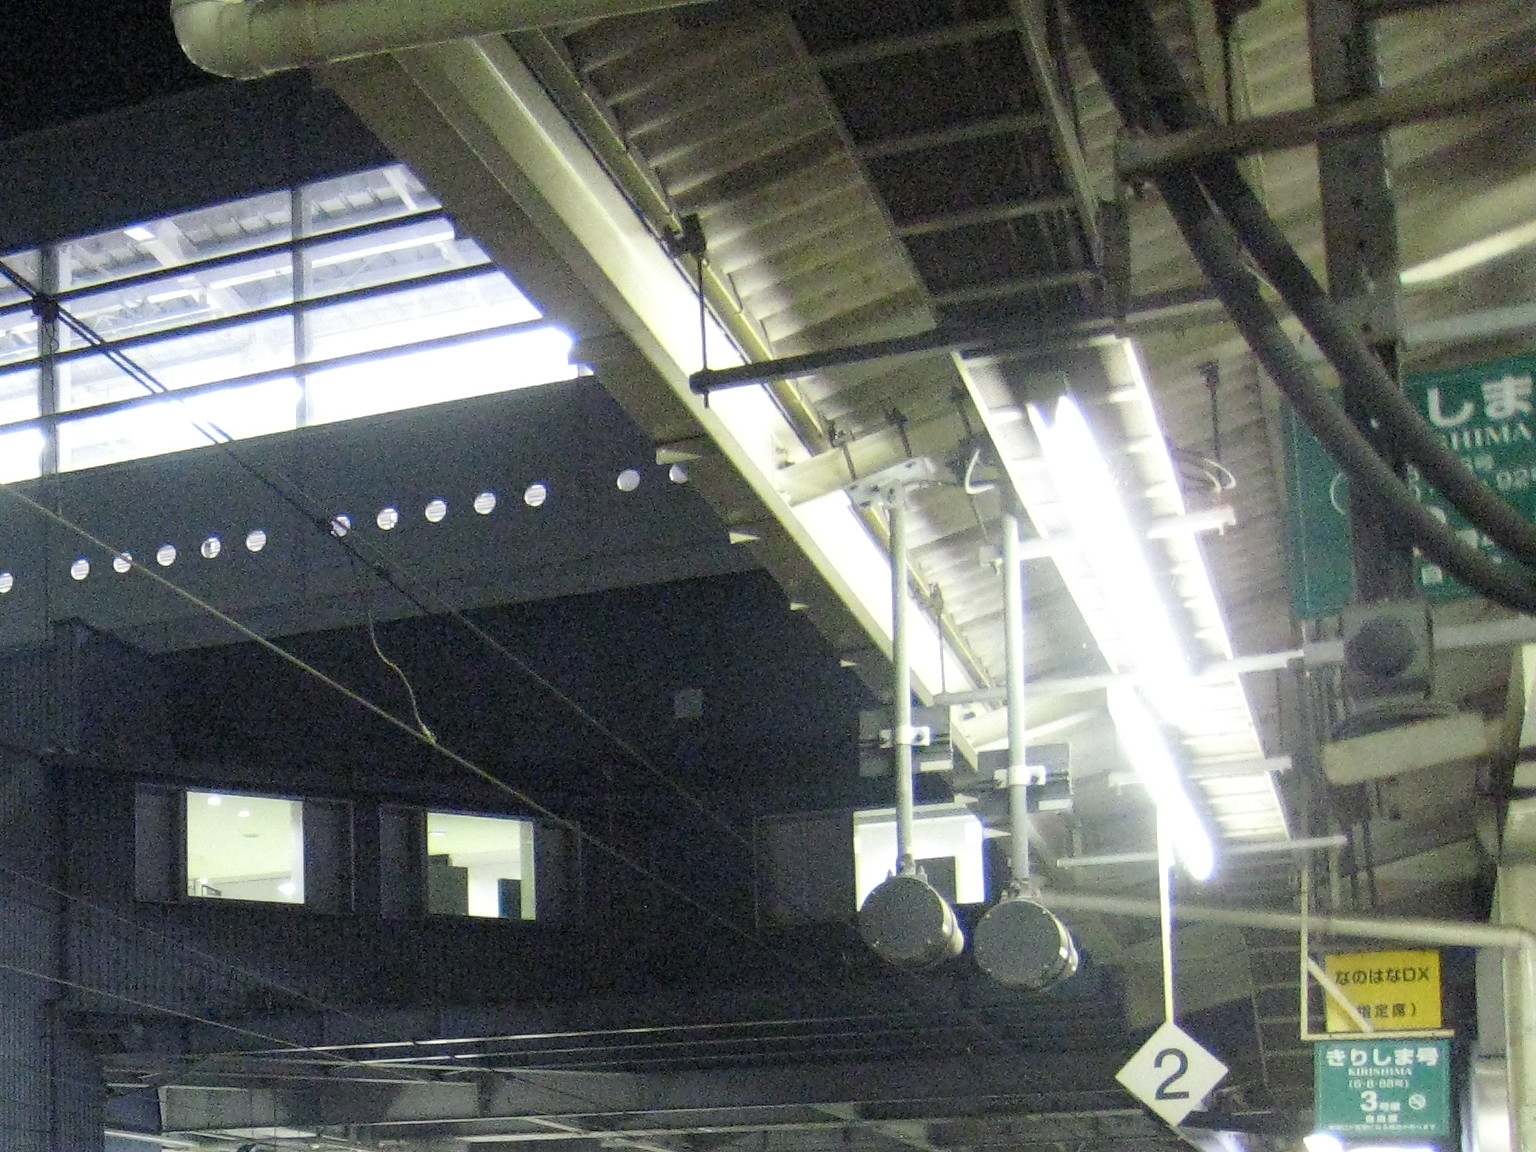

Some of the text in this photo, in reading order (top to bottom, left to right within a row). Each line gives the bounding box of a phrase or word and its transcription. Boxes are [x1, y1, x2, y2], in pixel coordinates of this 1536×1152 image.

[1335, 966, 1430, 986] なのはなDX
[1326, 1046, 1440, 1068] きりしま号
[1154, 1047, 1190, 1101] 2
[1348, 1067, 1413, 1077] KIRISHIMA
